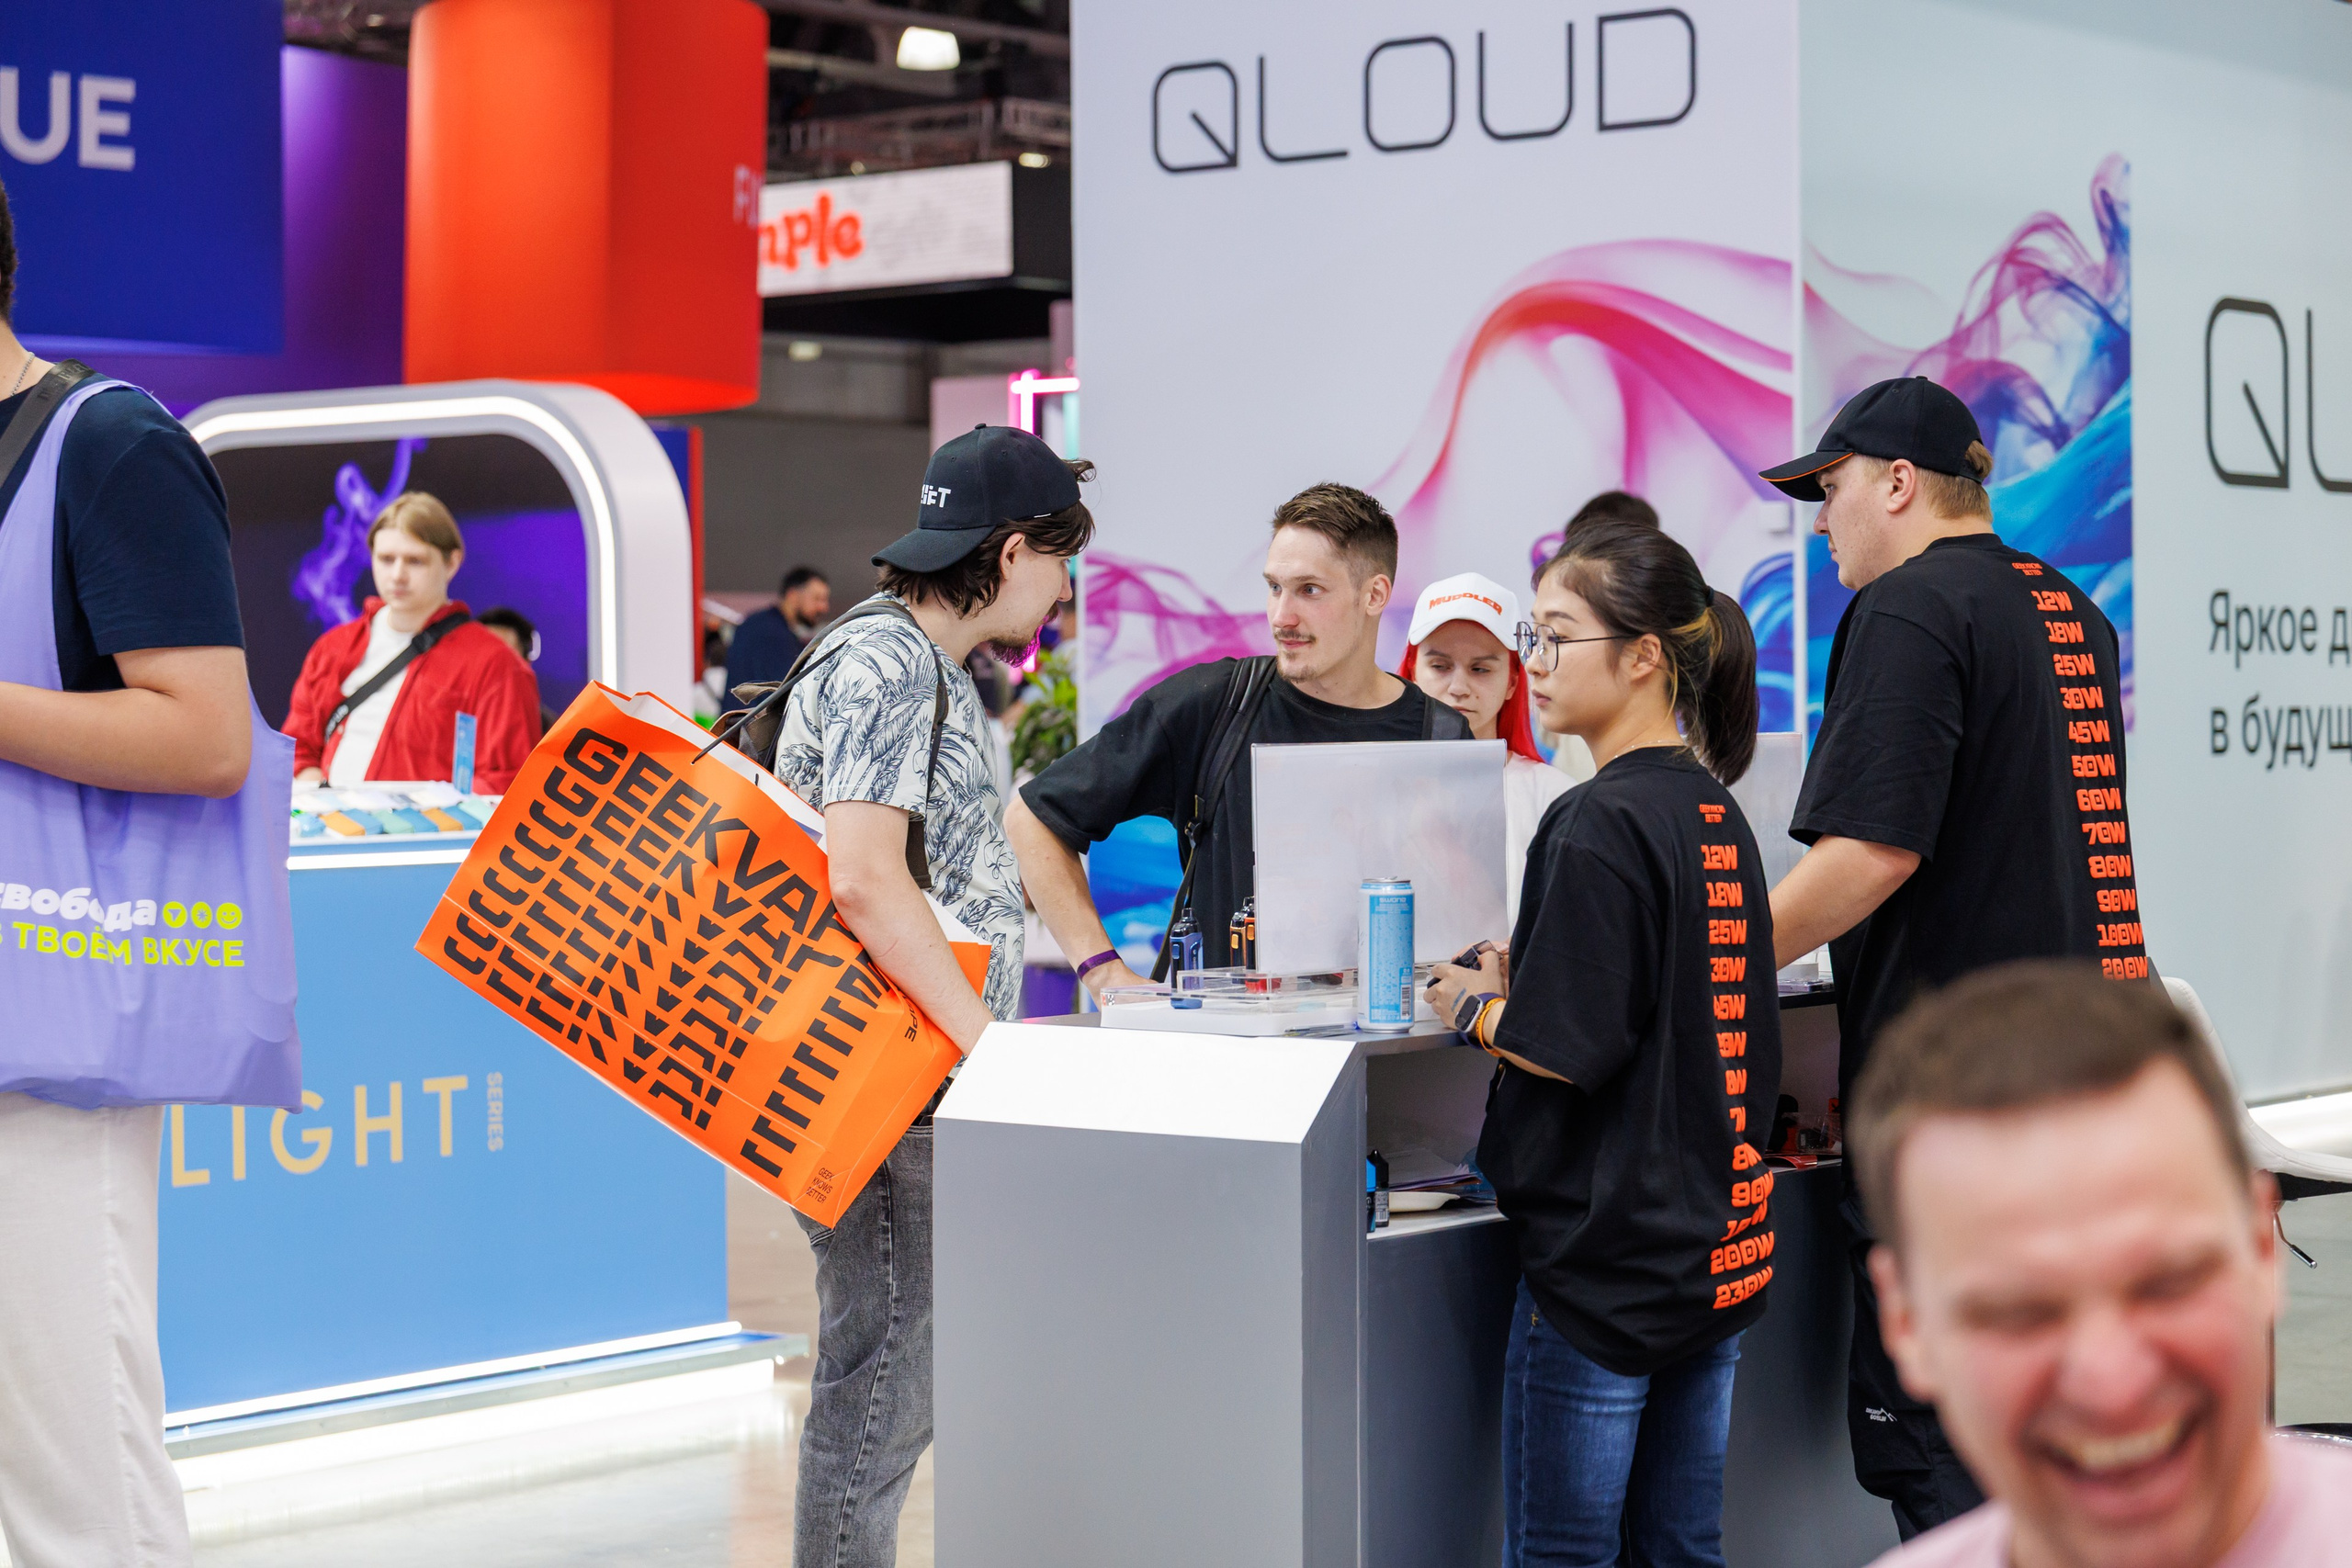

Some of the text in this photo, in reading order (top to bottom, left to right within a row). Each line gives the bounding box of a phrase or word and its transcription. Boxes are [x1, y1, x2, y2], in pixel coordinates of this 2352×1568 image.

[1152, 7, 1697, 173] QLOUD
[0, 65, 136, 172] UE
[1429, 592, 1503, 615] MUDDLER
[2030, 591, 2074, 612] 12W
[2045, 621, 2085, 643] 18W
[2209, 589, 2317, 671] Яркое
[2052, 653, 2096, 676] 25W
[2060, 686, 2104, 710] 30W
[2068, 720, 2110, 743] 45W
[2211, 706, 2229, 755] в
[2071, 754, 2116, 777] 50W
[2076, 787, 2122, 811] 60W
[2082, 821, 2126, 845] 70W
[1701, 845, 1738, 870] 12W
[2088, 855, 2132, 879] 80W
[1706, 882, 1743, 908] 18W
[2097, 889, 2136, 912] 90W
[0, 883, 157, 932] вобода
[1709, 919, 1747, 944] 25W
[2097, 922, 2143, 946] 100W
[12, 921, 132, 965] ТВОЁМ
[143, 937, 245, 967] ВКУСЕ
[1710, 956, 1747, 983] 30W
[2101, 956, 2148, 980] 200W
[171, 1071, 503, 1188] LIGHT SERIES
[811, 1177, 833, 1194] KNOWS
[1731, 1170, 1774, 1207] 90W
[1711, 1231, 1774, 1275] 200W
[1713, 1265, 1773, 1309] 230W
